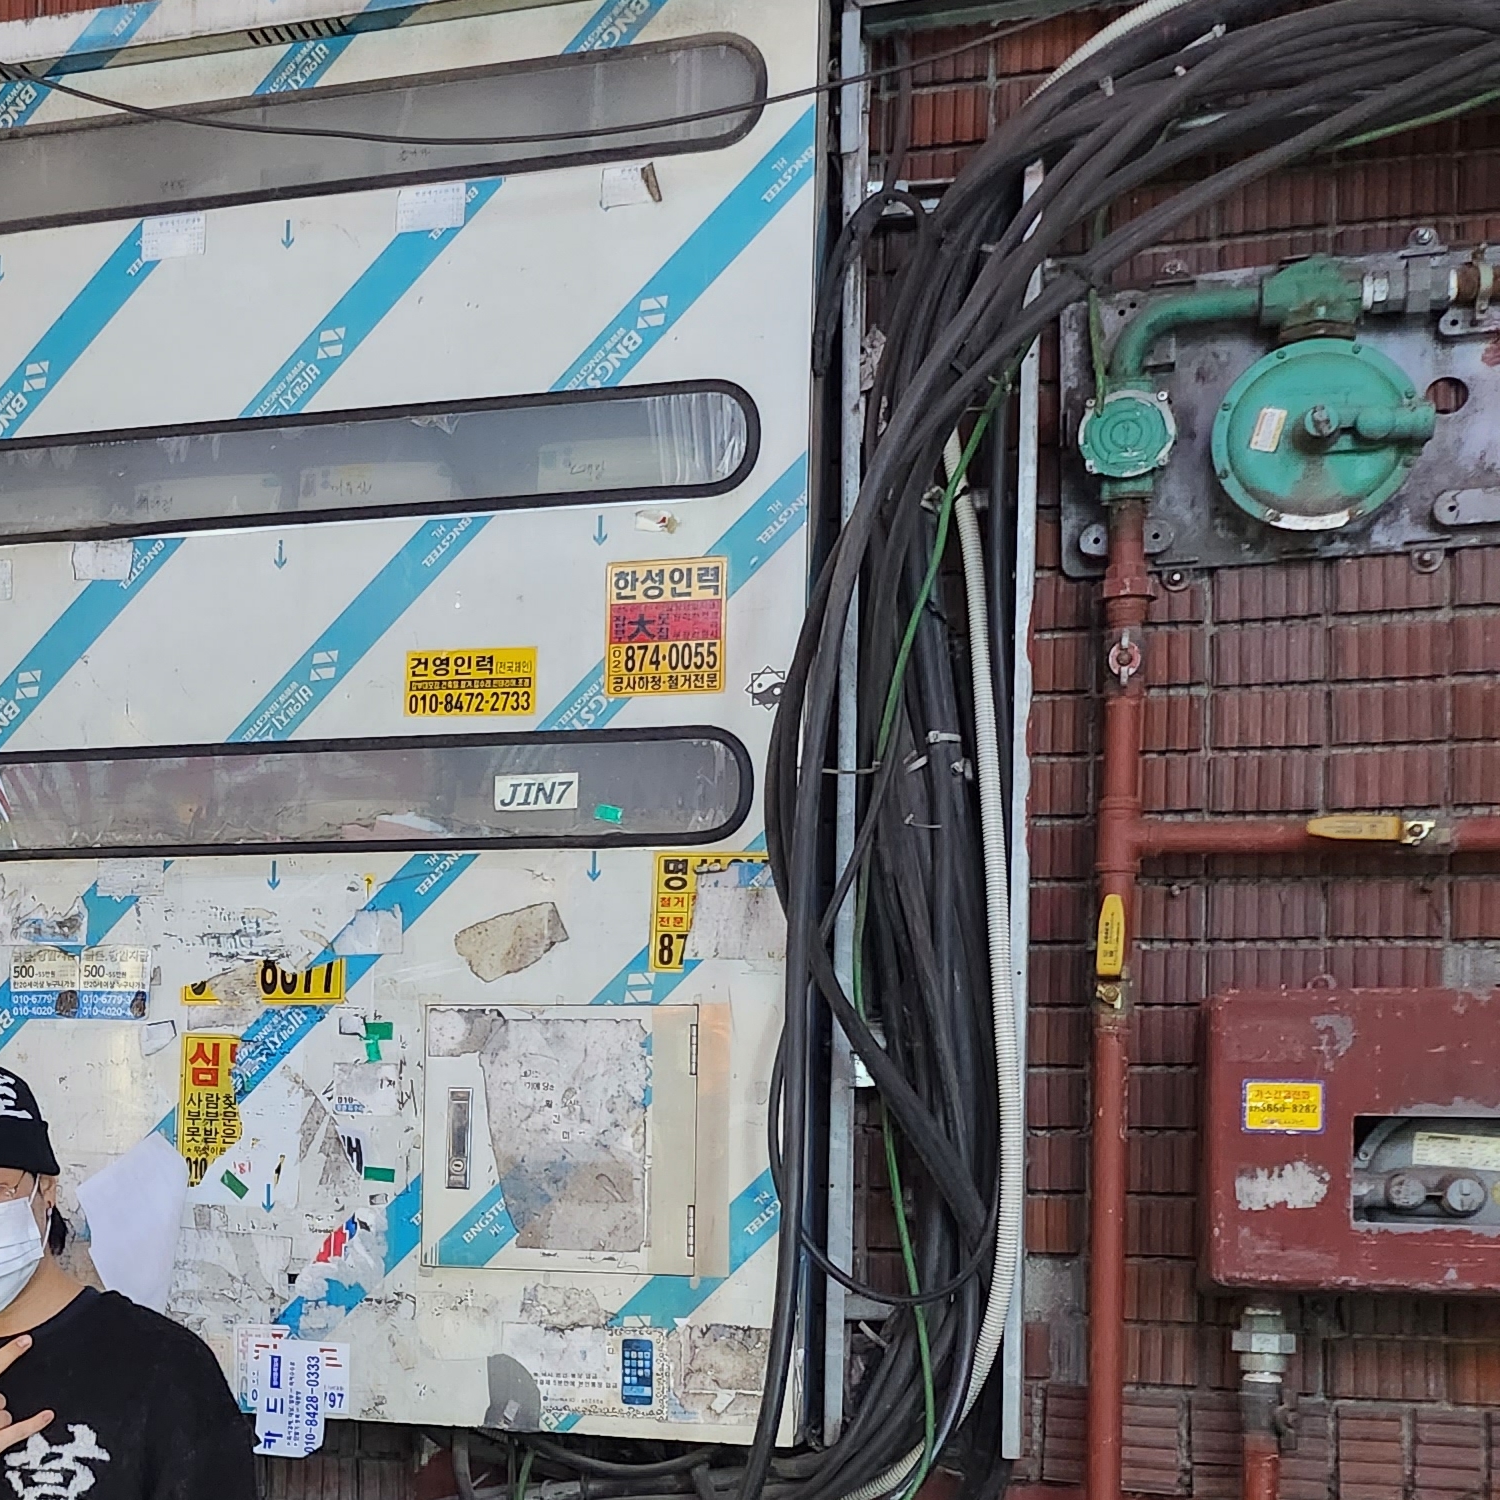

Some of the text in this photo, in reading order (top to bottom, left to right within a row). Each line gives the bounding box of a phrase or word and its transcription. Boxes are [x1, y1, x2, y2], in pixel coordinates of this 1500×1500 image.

[613, 565, 720, 601] 한성인력
[409, 654, 494, 677] 건영인력
[499, 779, 574, 809] JIN7
